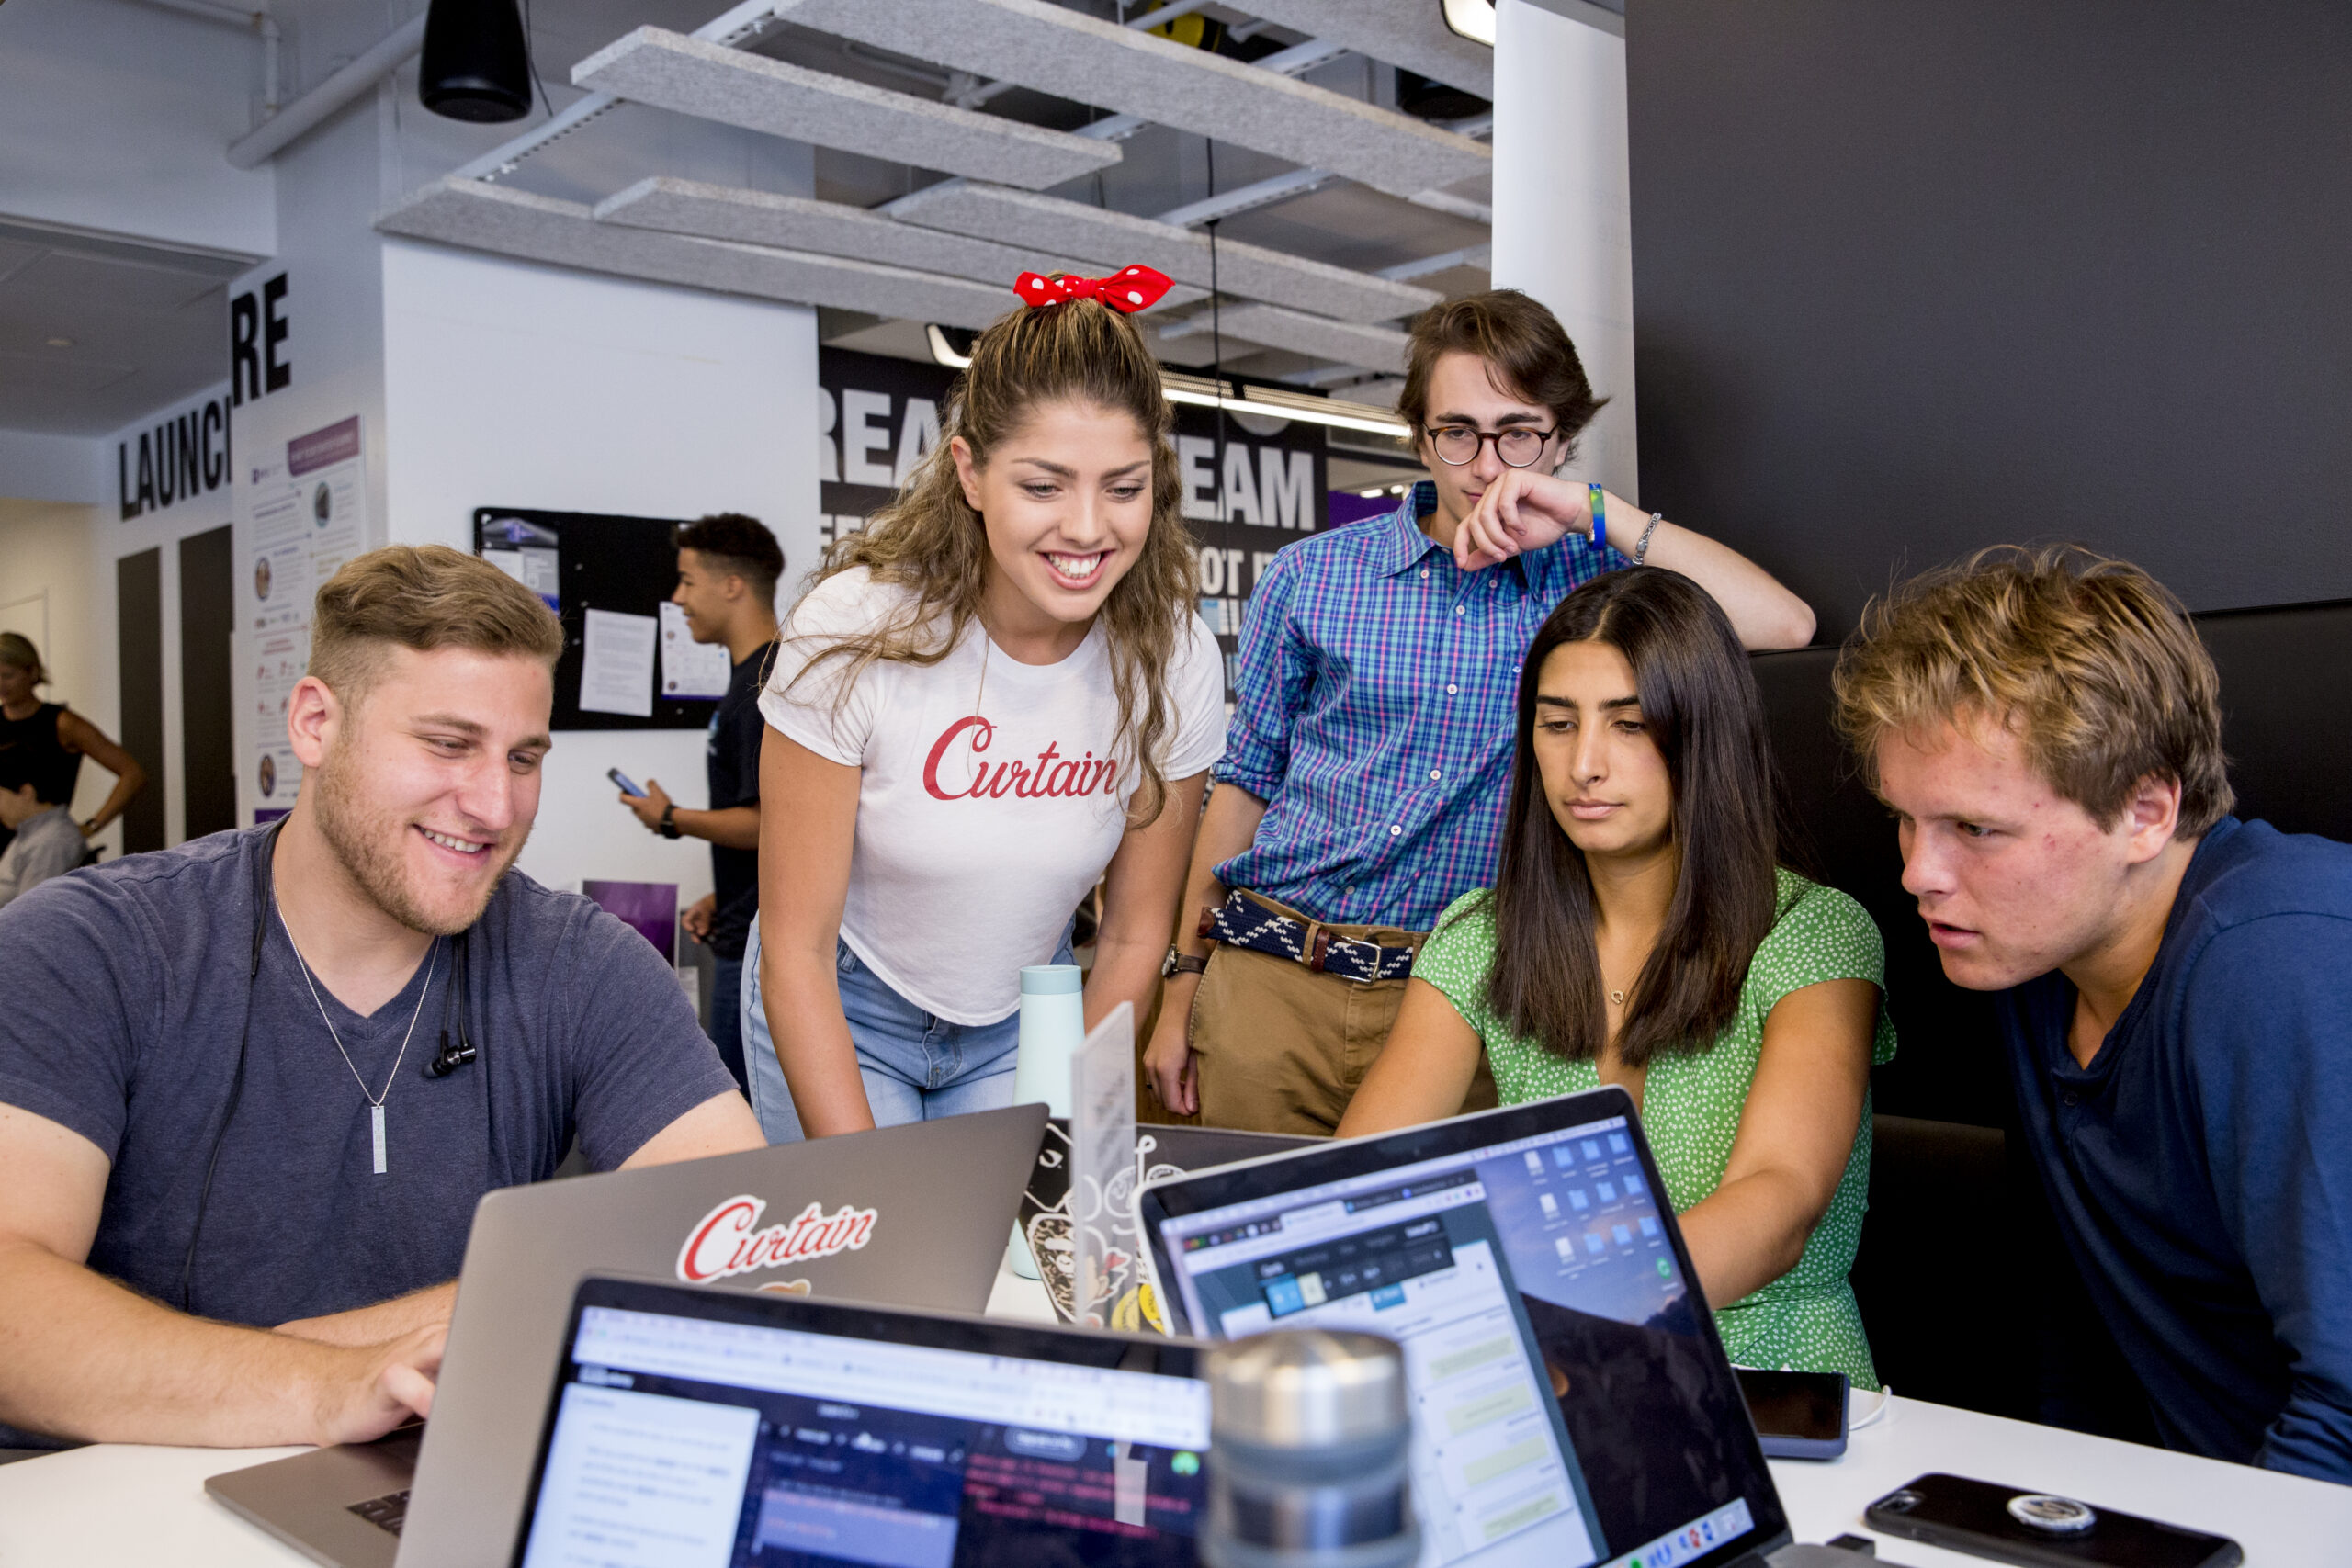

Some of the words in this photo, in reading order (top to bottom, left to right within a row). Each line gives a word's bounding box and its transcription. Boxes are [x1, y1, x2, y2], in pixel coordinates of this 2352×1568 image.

[231, 271, 291, 409] RE
[119, 395, 232, 522] LAUNC
[1164, 433, 1315, 531] EAM
[922, 715, 1118, 801] Curtain
[684, 1201, 873, 1282] Curtain
